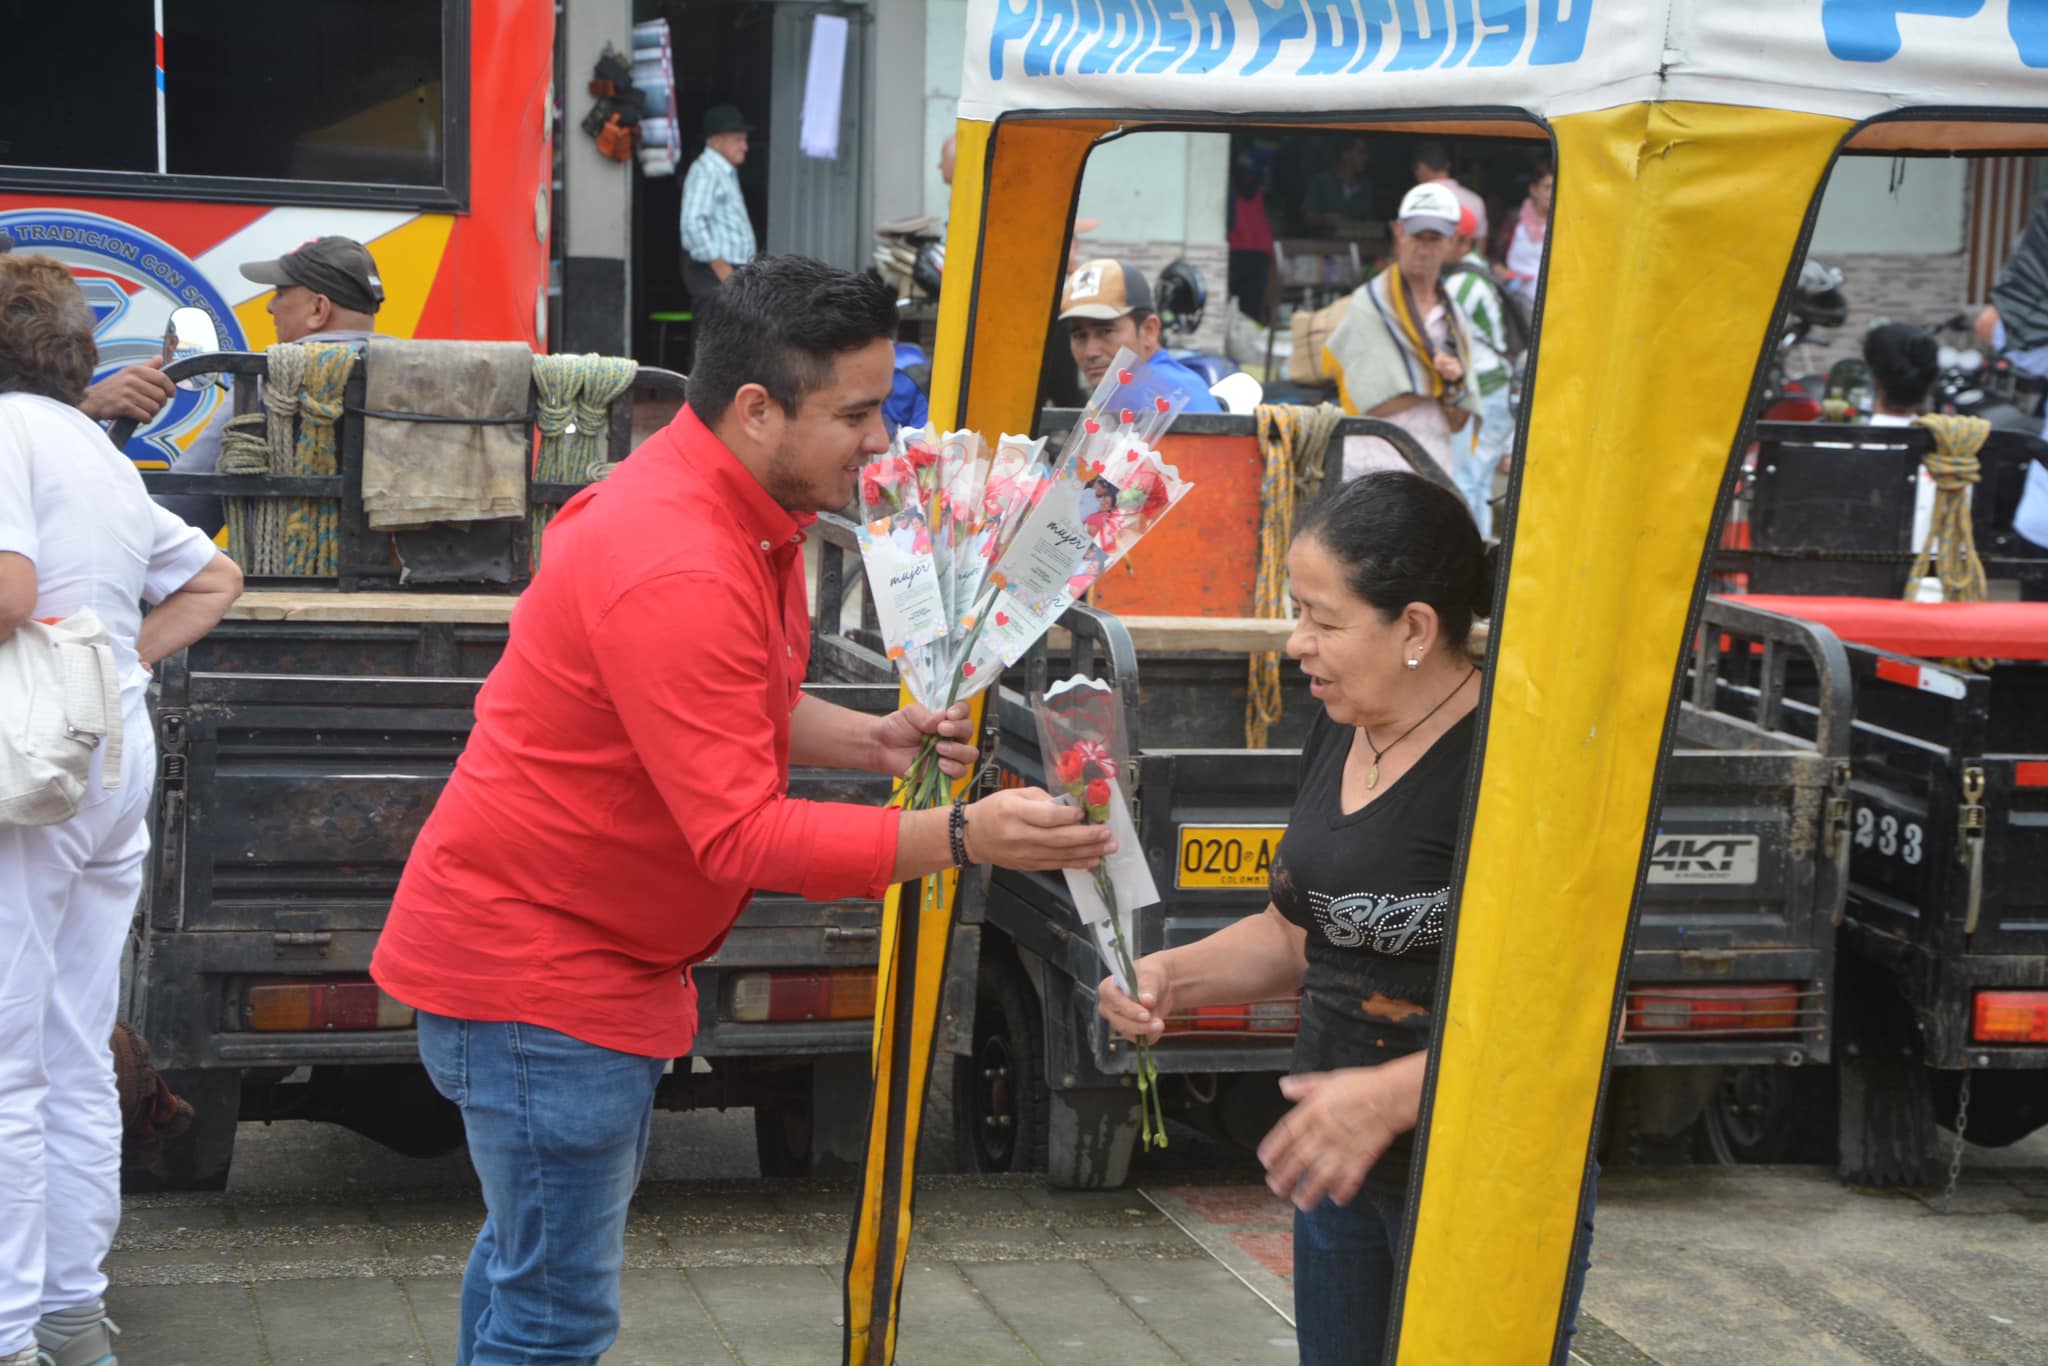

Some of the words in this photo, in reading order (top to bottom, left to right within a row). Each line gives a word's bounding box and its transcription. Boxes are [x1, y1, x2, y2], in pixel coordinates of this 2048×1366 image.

[16, 225, 139, 261] TRADICION
[141, 254, 185, 288] CON
[889, 563, 930, 589] mujer
[1855, 807, 1923, 865] 233
[1184, 838, 1242, 873] 020
[1650, 840, 1753, 871] AKT
[1221, 875, 1268, 885] COLOMBI
